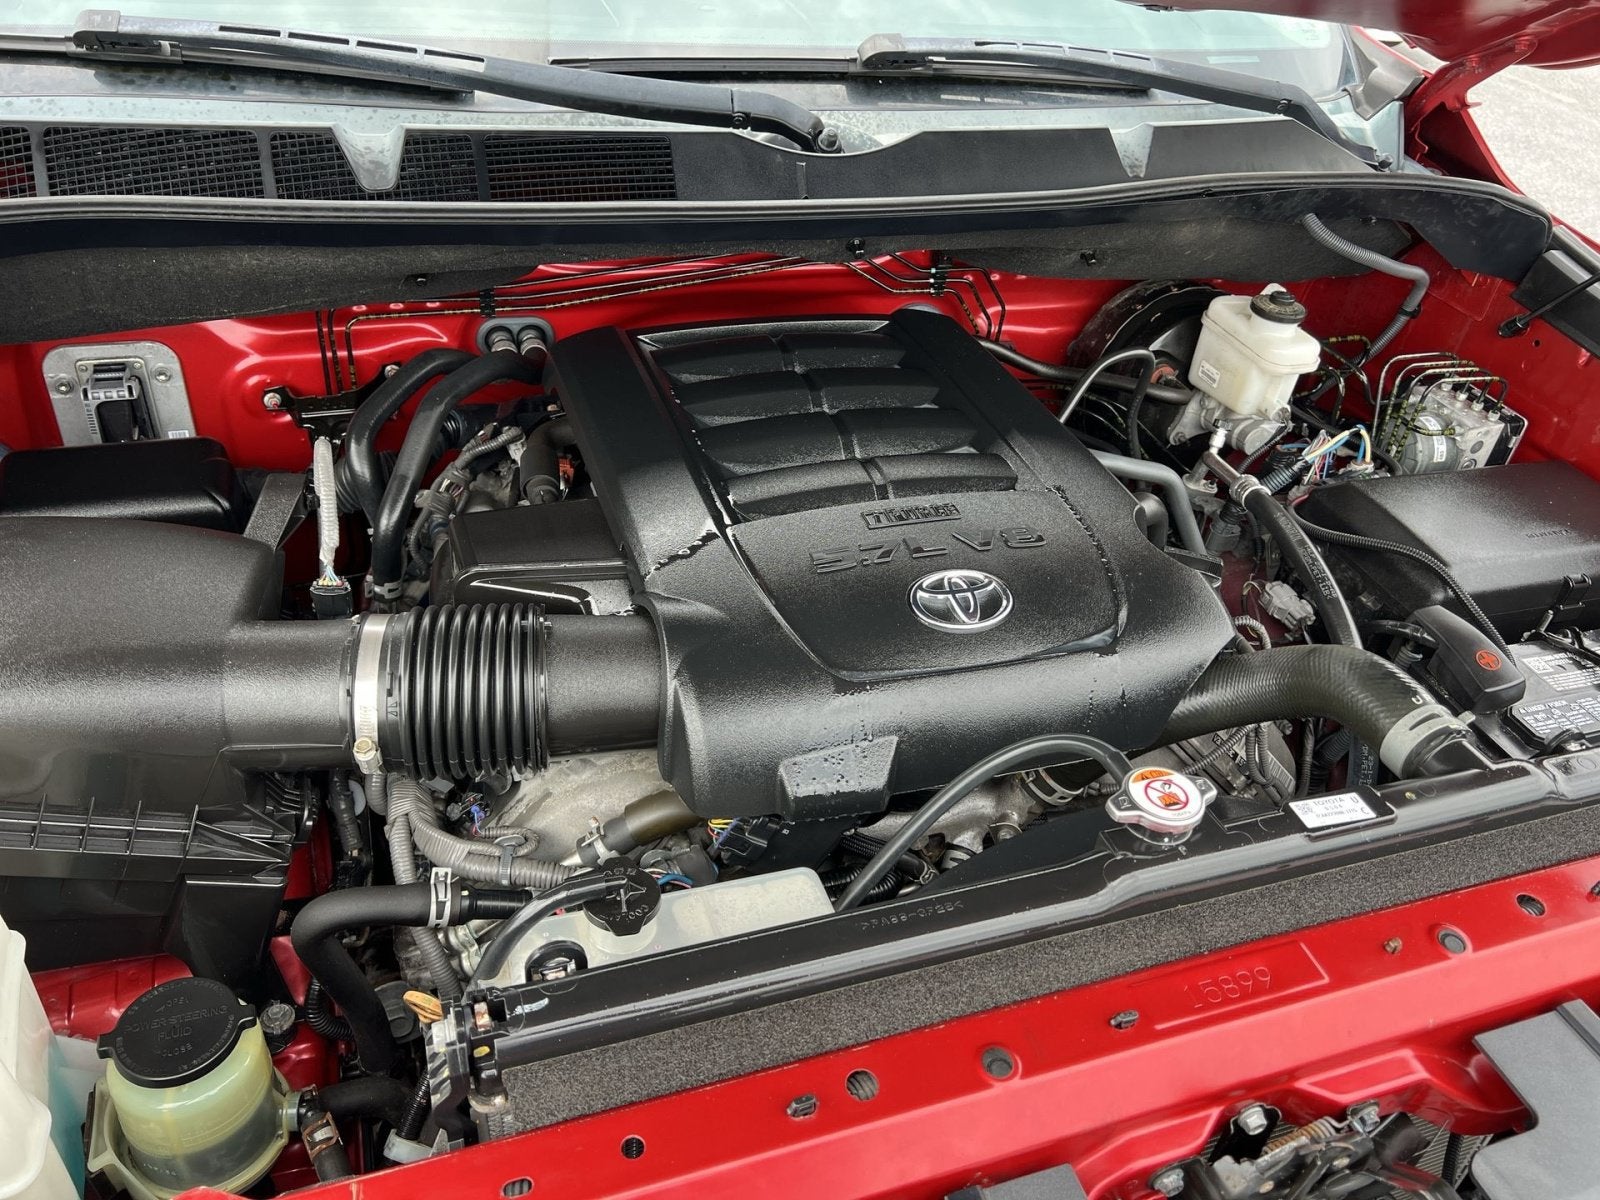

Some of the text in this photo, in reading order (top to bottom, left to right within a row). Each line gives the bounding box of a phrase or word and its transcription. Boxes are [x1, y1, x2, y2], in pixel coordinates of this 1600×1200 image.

[809, 526, 1047, 573] 5.7L V8
[1183, 966, 1272, 1009] 15899
[124, 1005, 229, 1033] POWER STEERING
[156, 1027, 193, 1041] FLUID
